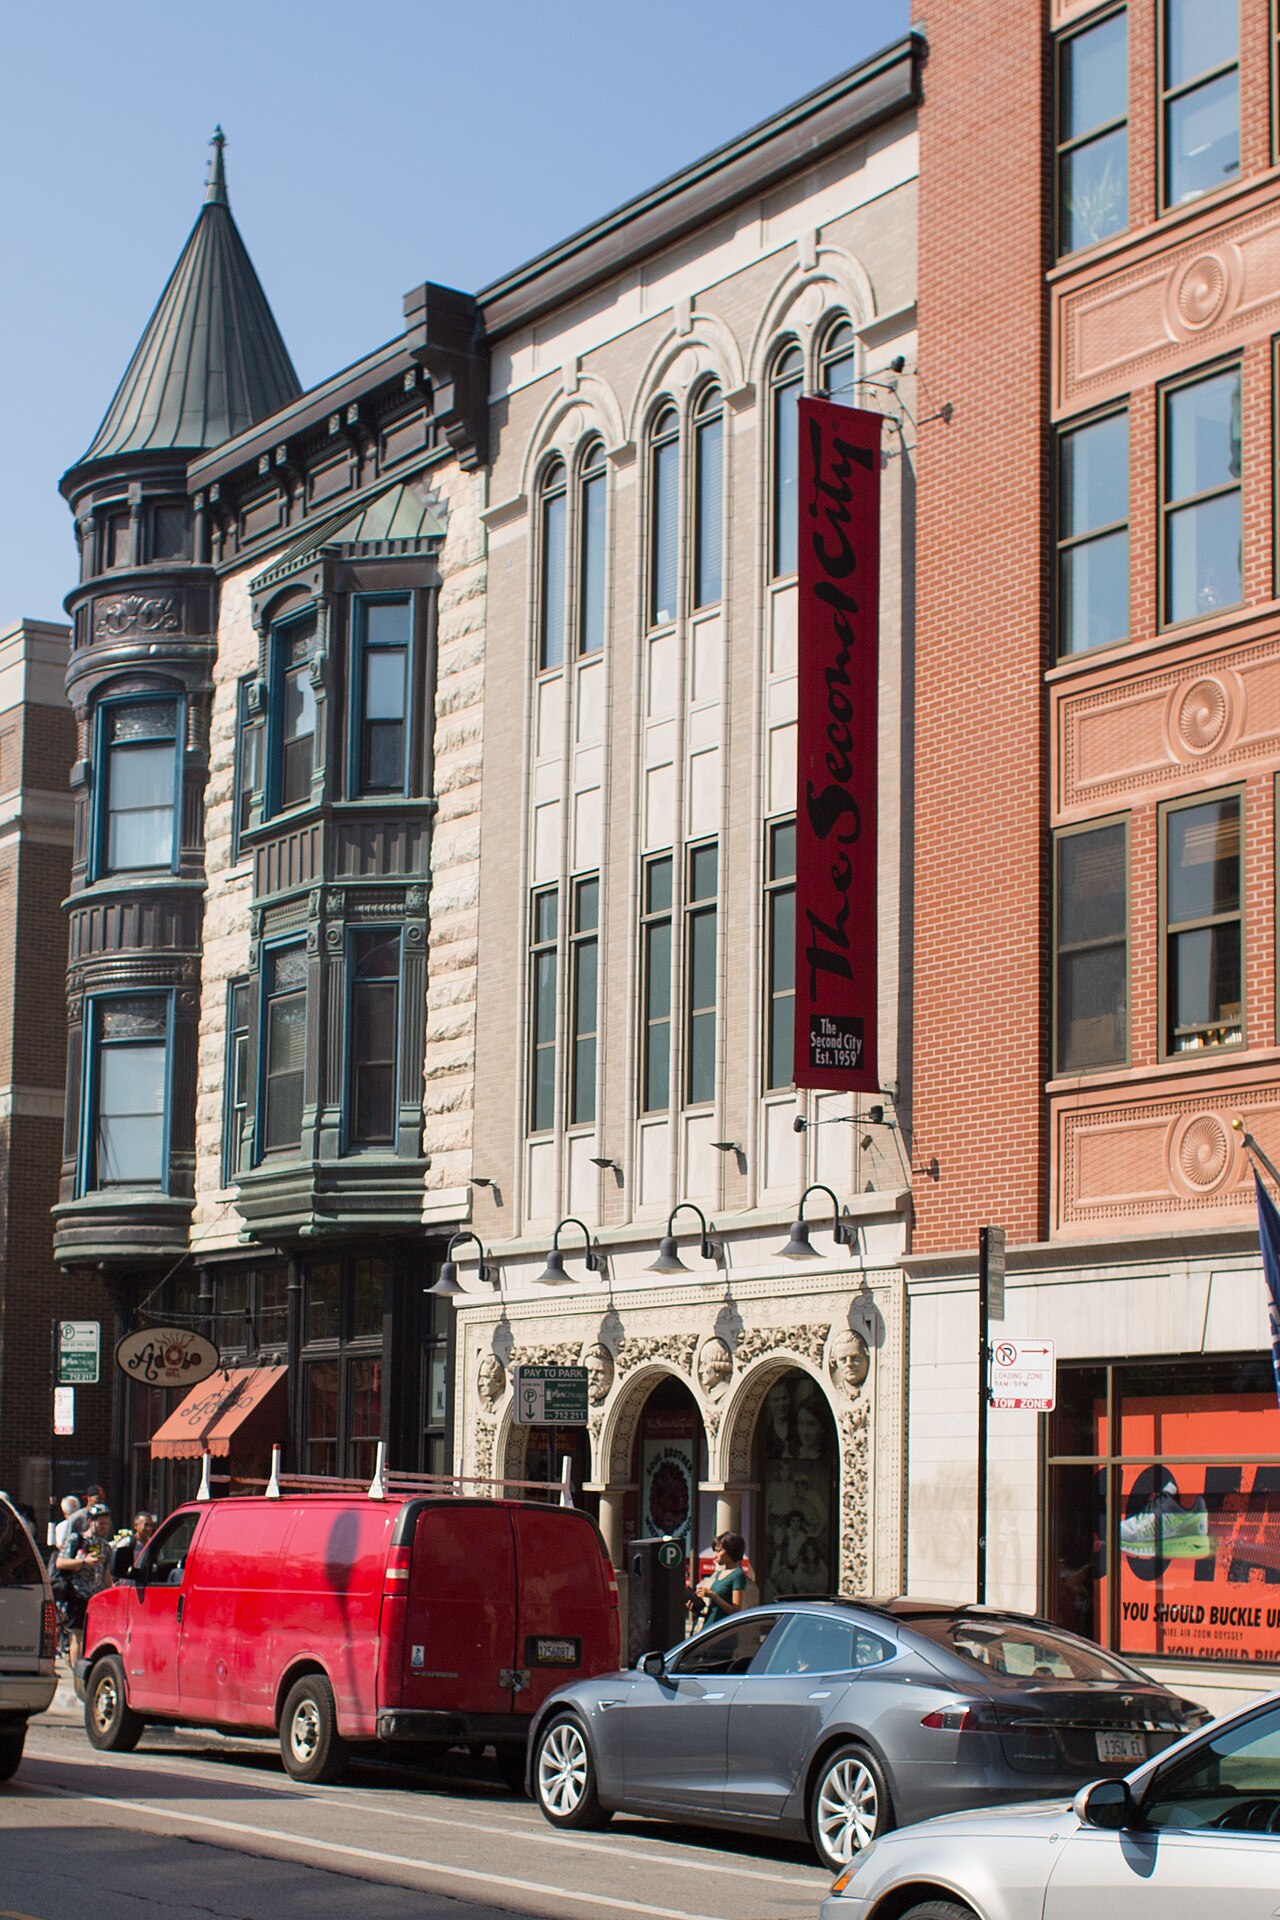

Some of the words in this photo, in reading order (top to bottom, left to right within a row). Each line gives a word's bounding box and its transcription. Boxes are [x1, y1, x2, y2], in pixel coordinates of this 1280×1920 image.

[808, 416, 874, 579] City
[806, 581, 862, 845] Second
[805, 851, 854, 1002] The
[820, 1018, 837, 1035] The
[810, 1031, 842, 1049] Second
[843, 1033, 862, 1055] City
[815, 1048, 833, 1065] Est.
[834, 1050, 857, 1067] 1959
[128, 1342, 202, 1380] Adobo
[523, 1368, 541, 1378] PAY
[543, 1368, 557, 1378] TO
[558, 1368, 583, 1378] PARK
[181, 1392, 254, 1425] Ado
[994, 1398, 1015, 1408] TOW
[1021, 1398, 1048, 1409] ZONE
[554, 1411, 569, 1419] 712
[570, 1411, 584, 1419] 211
[1123, 1602, 1149, 1621] YOU
[1153, 1603, 1205, 1624] SHOULD
[1210, 1606, 1262, 1627] BUCKLE
[1180, 1629, 1191, 1638] AIR
[1194, 1630, 1212, 1639] ZOOM
[1214, 1631, 1244, 1641] ODYSSEY
[1131, 1741, 1144, 1757] EL
